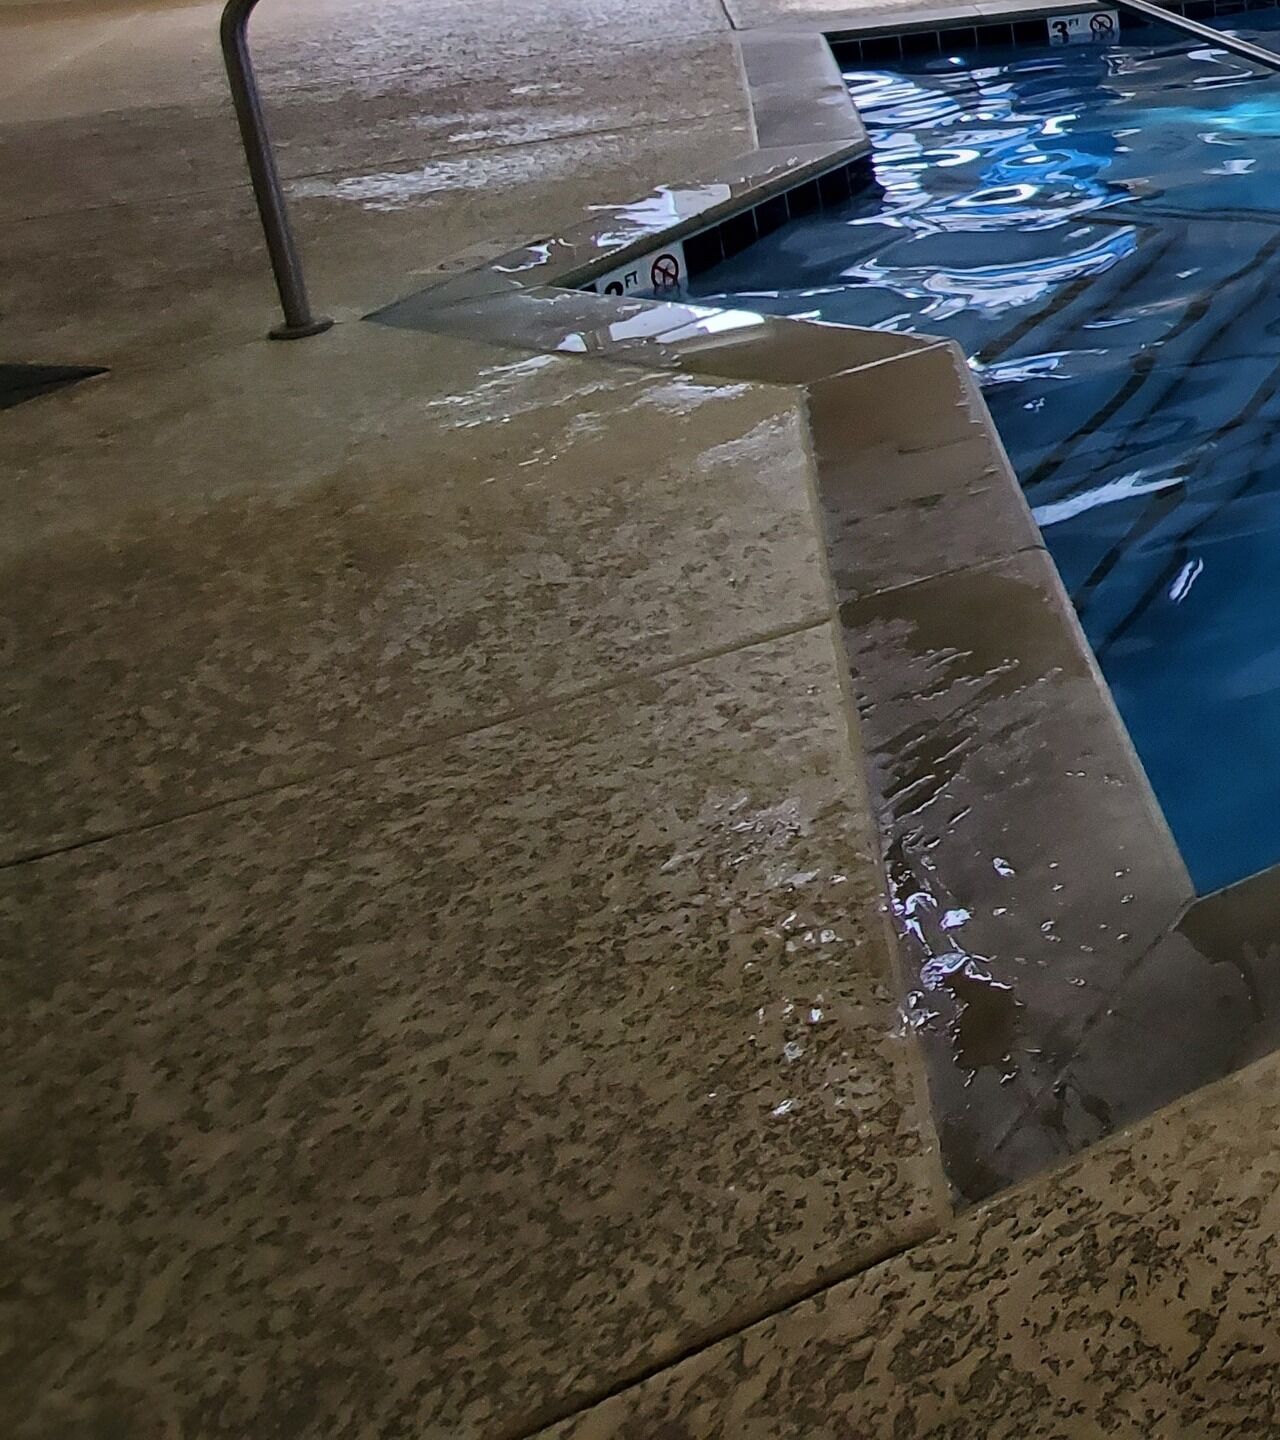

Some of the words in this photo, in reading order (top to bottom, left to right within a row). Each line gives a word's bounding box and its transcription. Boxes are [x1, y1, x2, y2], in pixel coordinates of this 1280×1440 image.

[1052, 22, 1069, 43] 3
[1069, 19, 1079, 27] FT
[624, 270, 638, 288] FT
